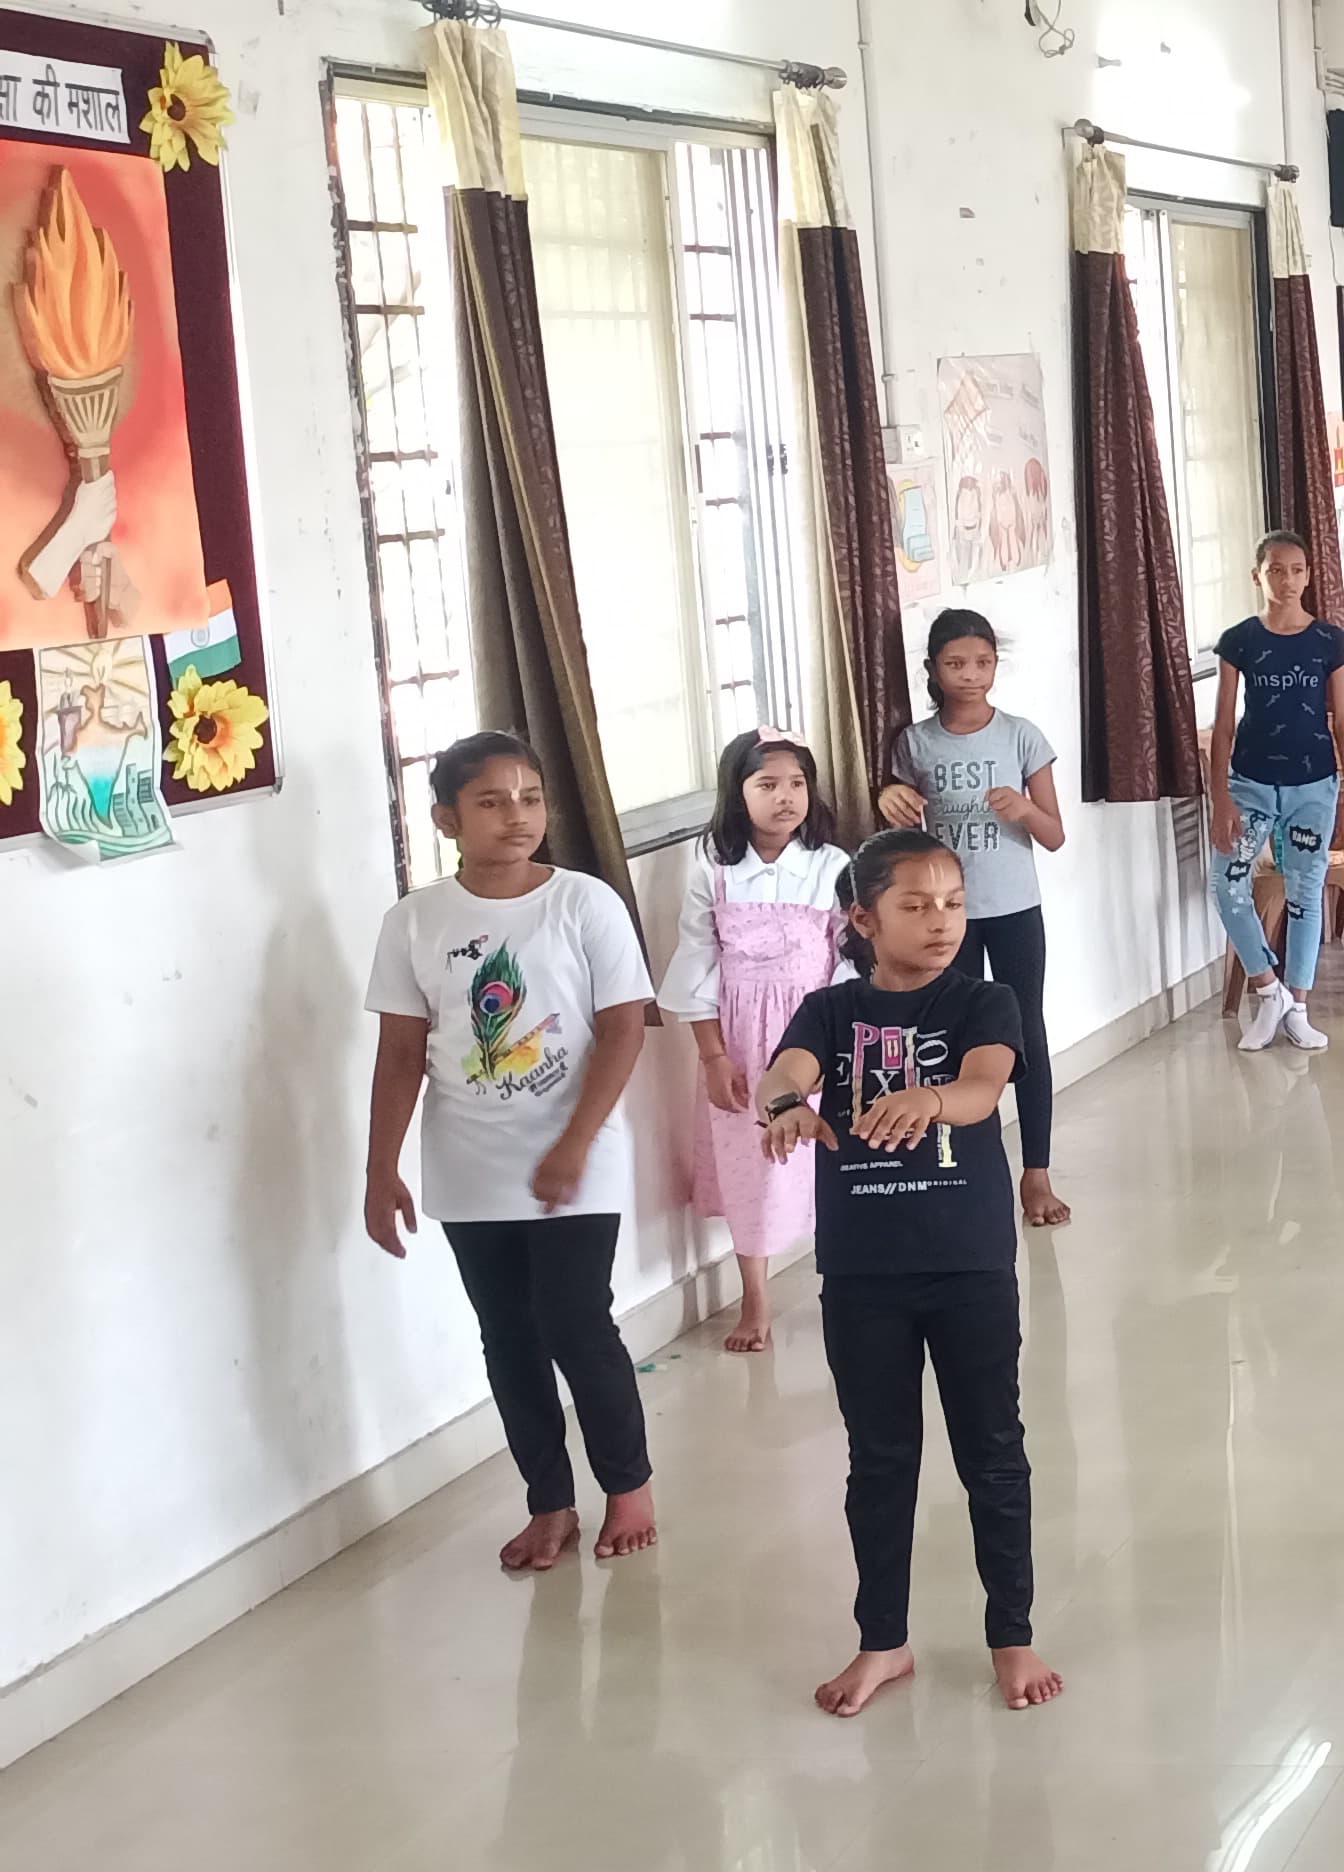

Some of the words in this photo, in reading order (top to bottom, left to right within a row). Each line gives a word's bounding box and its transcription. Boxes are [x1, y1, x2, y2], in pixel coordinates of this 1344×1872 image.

[32, 63, 60, 126] की
[65, 82, 121, 133] मशाल
[934, 760, 997, 792] BEST
[935, 822, 999, 850] EVER
[496, 1046, 569, 1101] Kaanha
